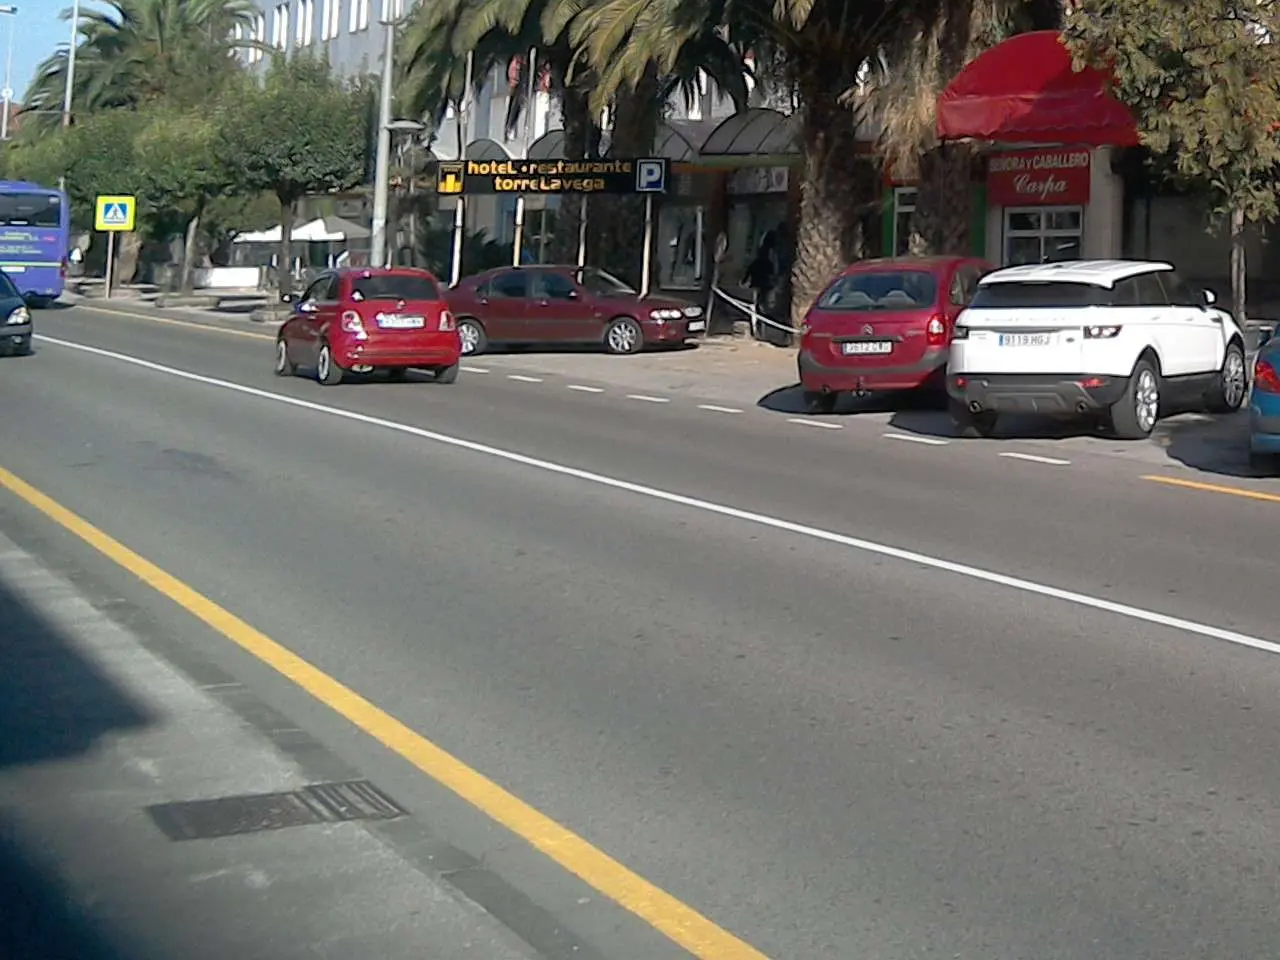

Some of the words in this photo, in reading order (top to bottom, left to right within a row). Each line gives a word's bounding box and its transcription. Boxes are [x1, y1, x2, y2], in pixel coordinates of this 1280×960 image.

[530, 161, 632, 175] restaurante
[1033, 152, 1089, 170] CABALLERO
[495, 176, 605, 191] torrelavega
[644, 163, 661, 188] P
